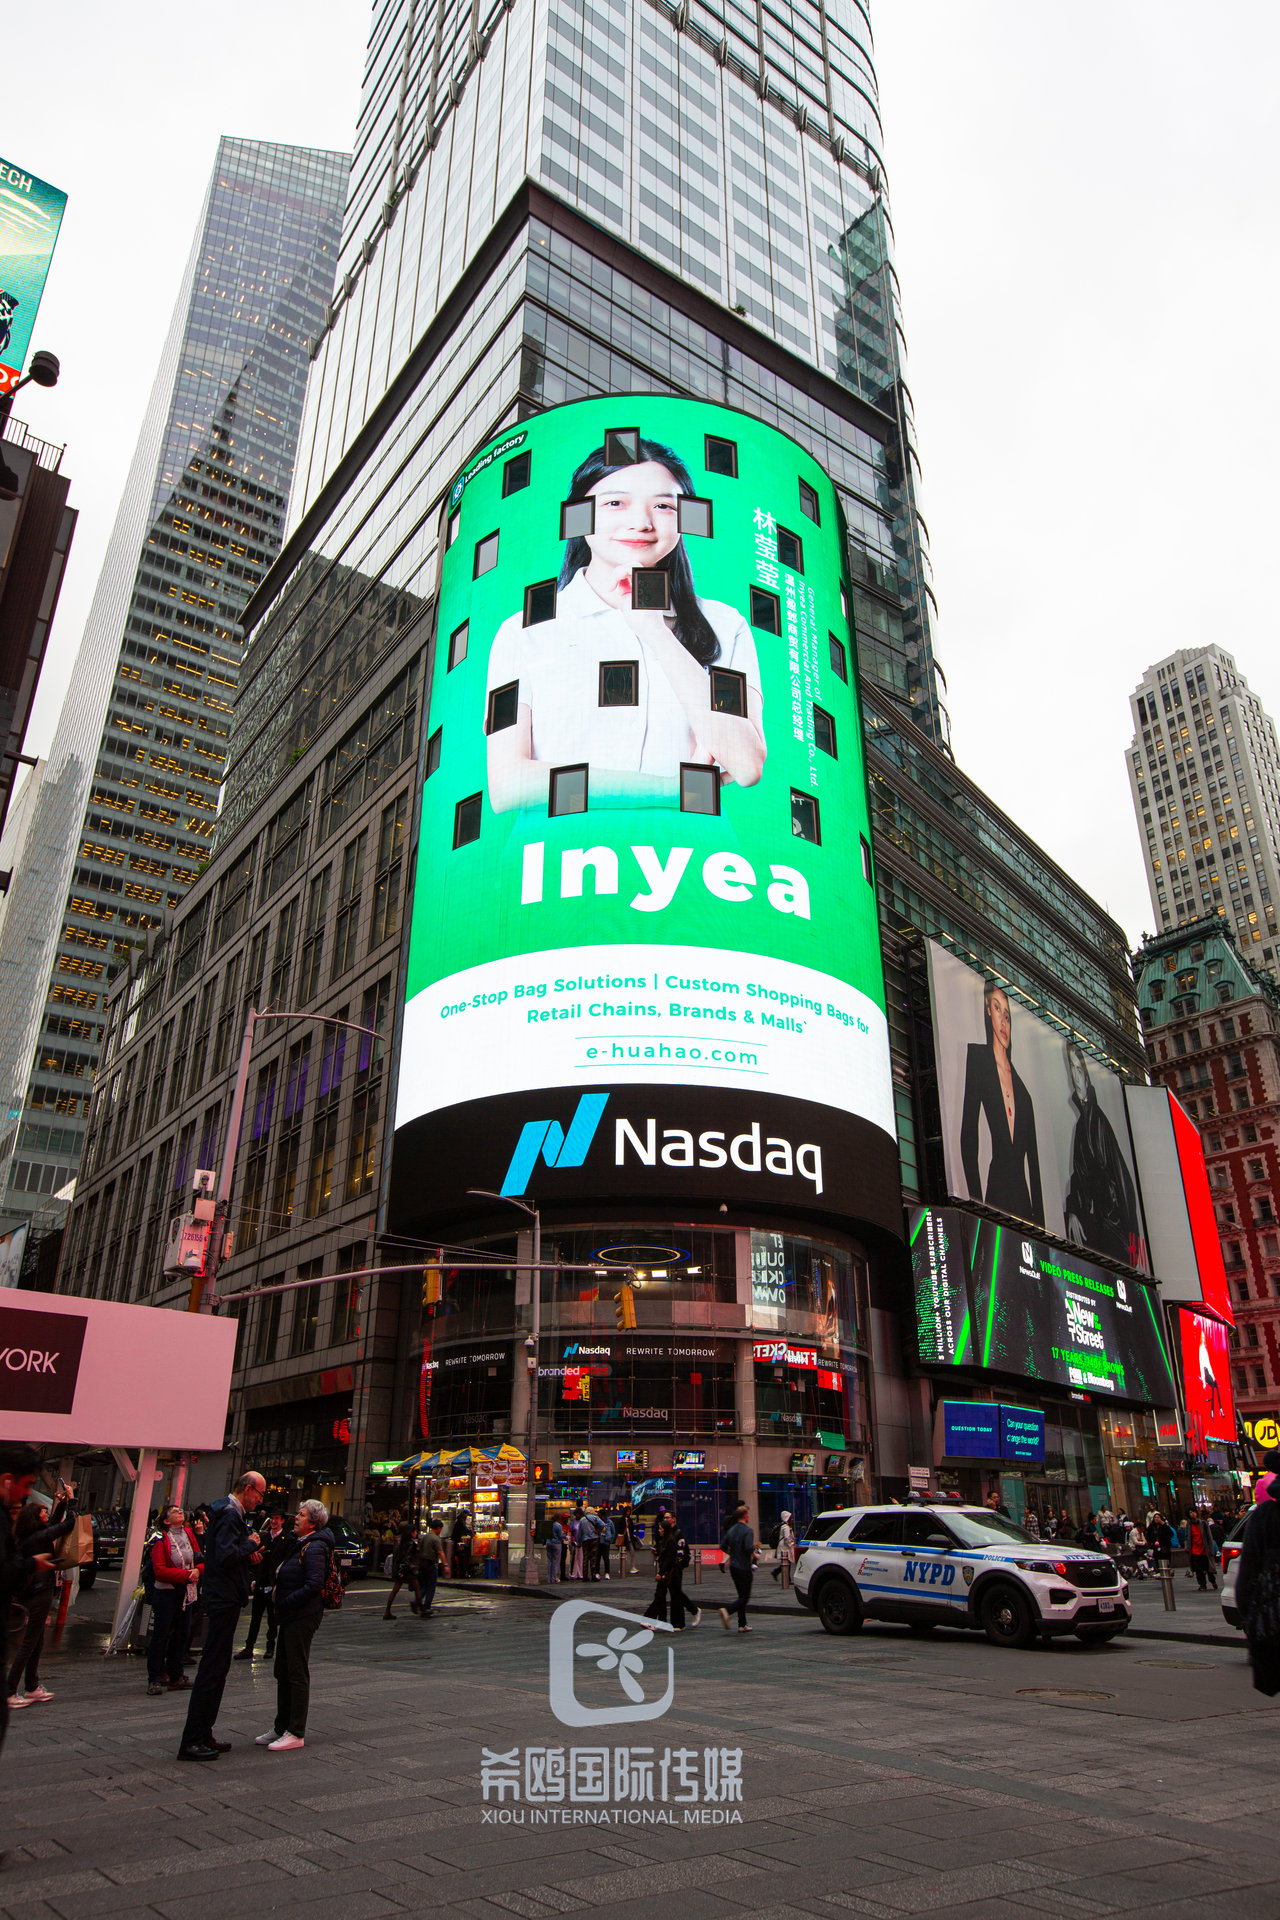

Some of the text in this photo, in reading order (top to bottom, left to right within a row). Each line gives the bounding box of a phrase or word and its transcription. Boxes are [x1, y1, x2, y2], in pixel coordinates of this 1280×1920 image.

[465, 434, 524, 483] Leading factory
[752, 506, 780, 590] 林莹莹
[807, 586, 823, 702] General Manager of
[797, 580, 818, 787] Inyea Commercial And Trading Co., Ltd.
[520, 840, 811, 921] Inyea
[440, 989, 508, 1019] One-Stop
[514, 983, 547, 998] Bag
[553, 974, 647, 992] Solutions
[665, 975, 740, 994] Custom
[746, 983, 822, 1016] Shopping
[826, 1003, 854, 1027] Bags
[857, 1017, 869, 1035] for
[527, 1003, 581, 1023] Retail
[588, 1001, 662, 1018] Chains,
[669, 1003, 737, 1021] Brands
[743, 1010, 755, 1024] &
[586, 1043, 758, 1065] e-huahao.com
[615, 1117, 823, 1195] Nasdaq
[926, 1211, 937, 1267] SUBSCRIBERS
[930, 1269, 940, 1309] YOUTUBE
[936, 1217, 955, 1355] ACROSS OUR DIGITAL CHANNELS
[1040, 1259, 1115, 1298] VIDEO PRESS RELEASES
[1065, 1290, 1090, 1305] DISTRIBUTED
[1072, 1300, 1094, 1329] New
[935, 1311, 944, 1353] MILLION+
[1076, 1323, 1105, 1350] Street
[445, 1356, 467, 1366] REWRITE
[469, 1352, 506, 1363] TOMORROW
[578, 1345, 716, 1357] Nasdaq REWRITE TOMORROW
[818, 1358, 839, 1369] REWRITE
[1051, 1346, 1059, 1359] 17
[1060, 1348, 1083, 1366] YEARS
[537, 1366, 580, 1377] branded
[622, 1406, 669, 1421] Nasdaq
[1006, 1418, 1016, 1428] Can
[983, 1554, 1006, 1563] POLICE
[903, 1560, 956, 1587] NYPD
